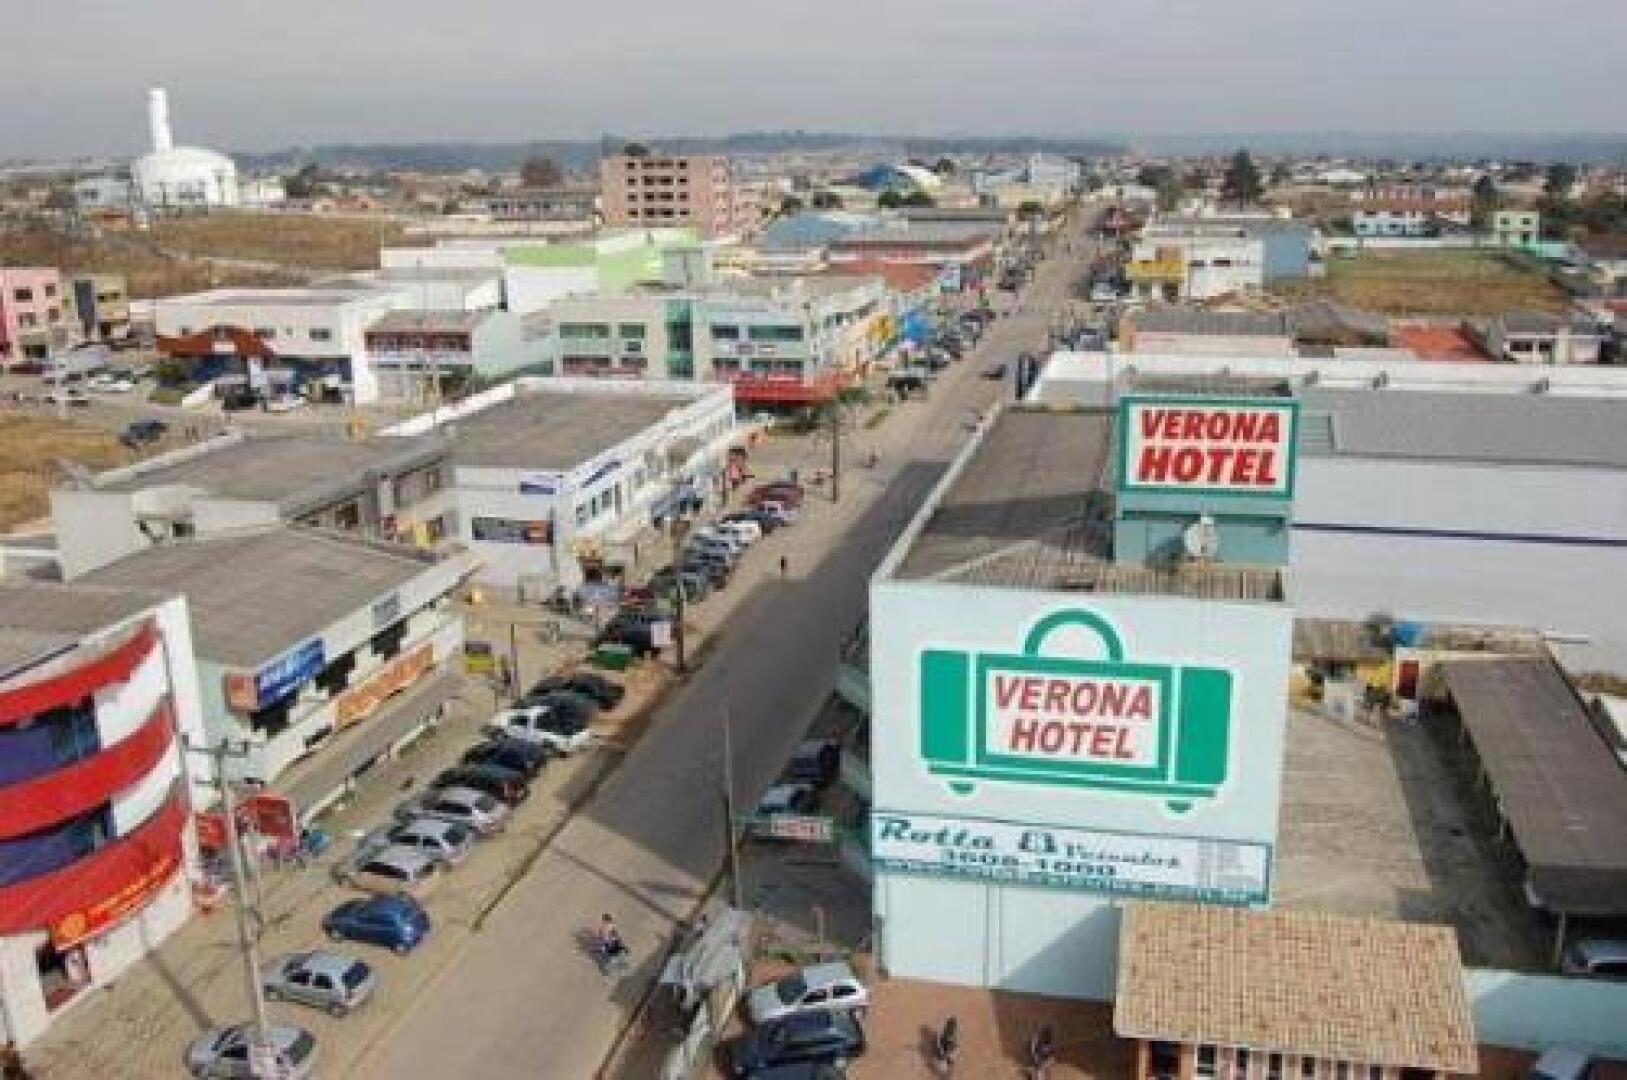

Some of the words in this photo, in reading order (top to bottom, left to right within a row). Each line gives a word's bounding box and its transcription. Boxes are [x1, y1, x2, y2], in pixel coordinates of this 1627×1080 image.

[1142, 410, 1279, 442] VERONA
[1139, 446, 1277, 483] HOTEL
[995, 676, 1153, 719] VERONA
[1010, 719, 1134, 759] HOTEL
